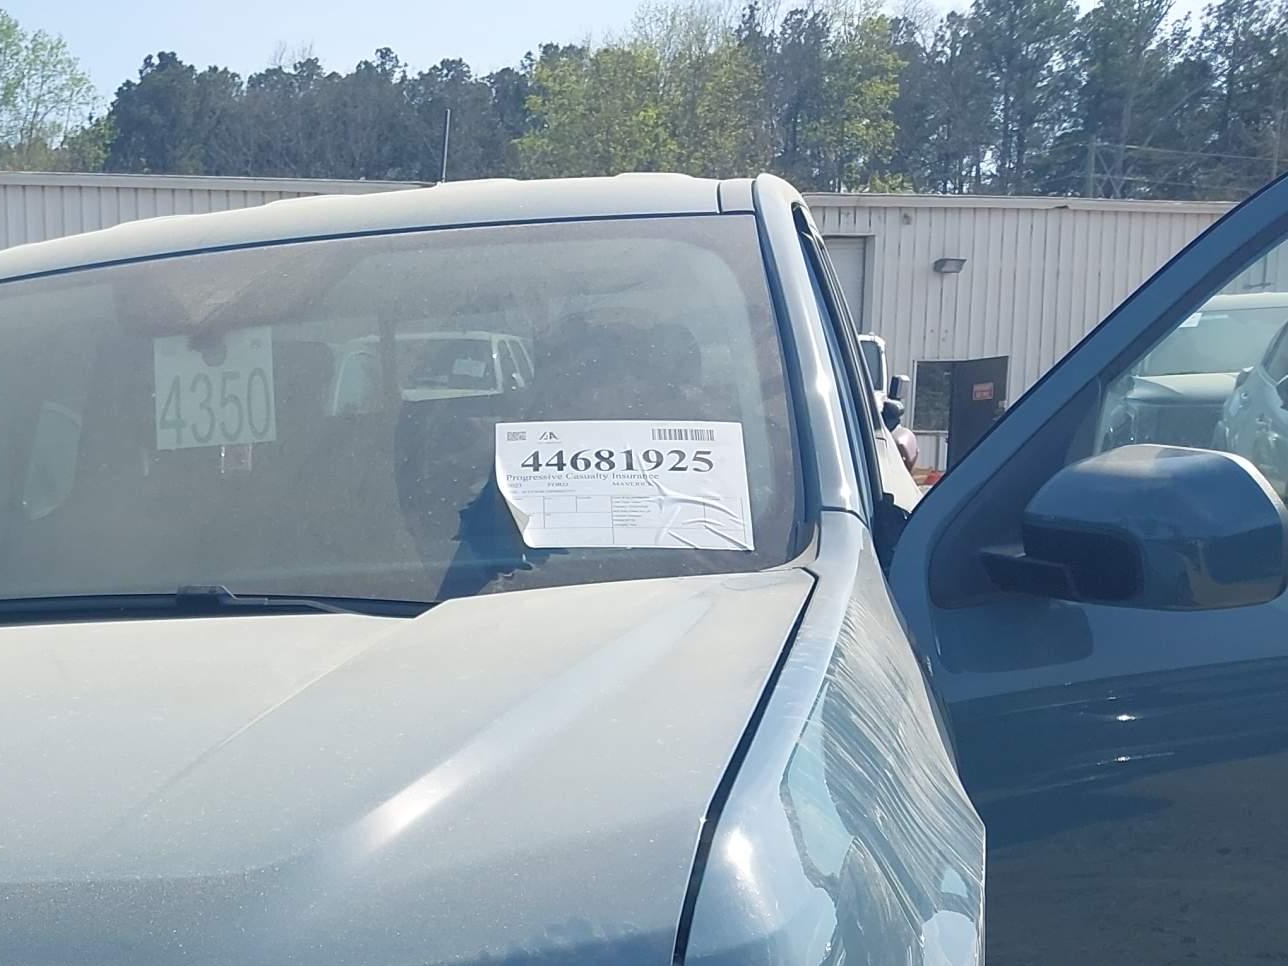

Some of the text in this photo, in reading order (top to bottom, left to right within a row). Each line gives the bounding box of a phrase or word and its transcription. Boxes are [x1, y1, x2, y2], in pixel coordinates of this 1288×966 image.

[160, 367, 271, 446] 4350
[520, 448, 714, 473] 44681925
[506, 474, 563, 482] Progressive
[565, 472, 609, 481] Casualty
